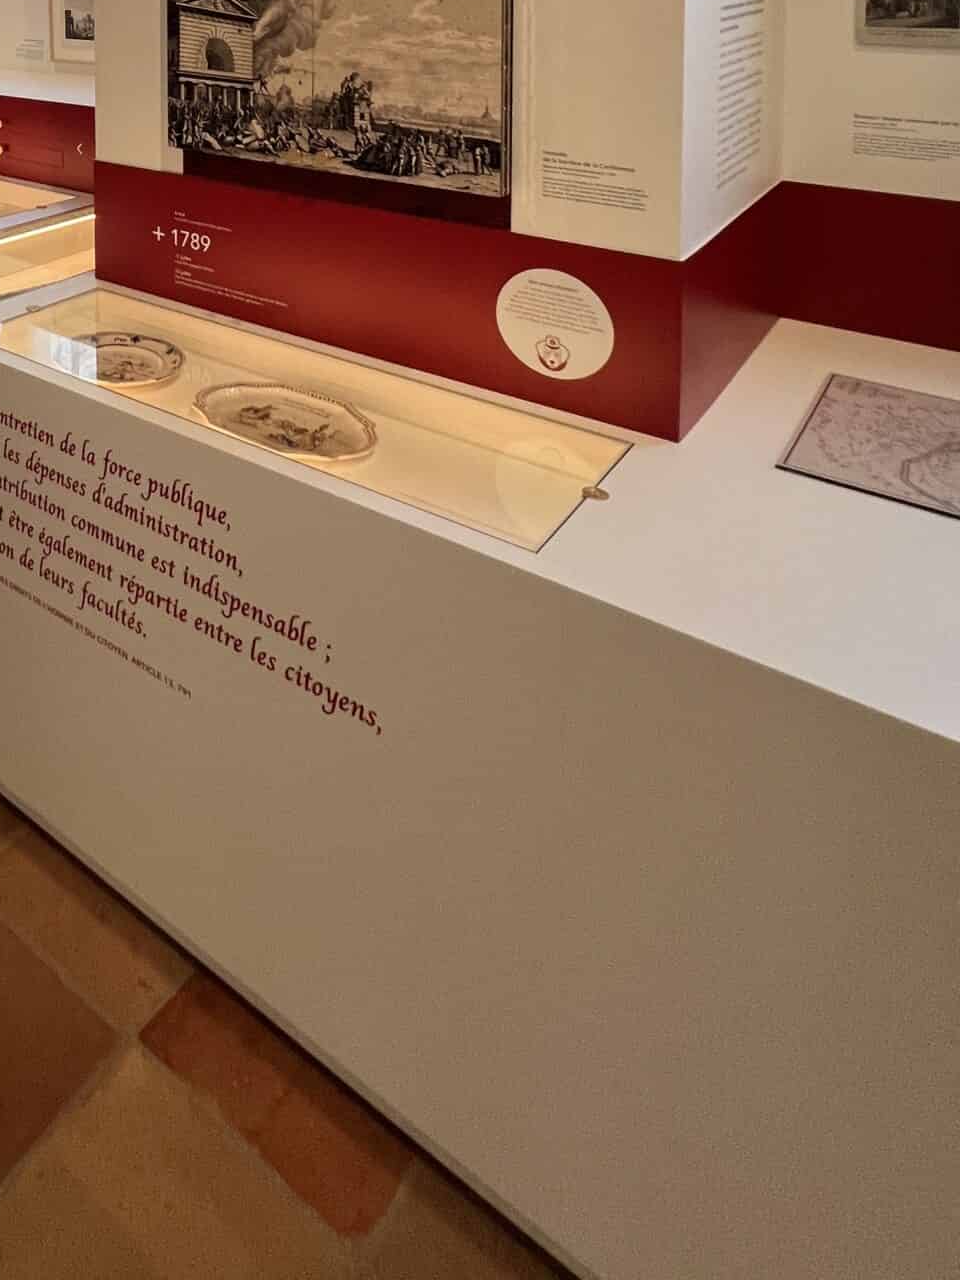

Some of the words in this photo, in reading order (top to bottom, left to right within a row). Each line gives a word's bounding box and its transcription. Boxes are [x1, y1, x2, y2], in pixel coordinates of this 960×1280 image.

[170, 228, 211, 253] 1789
[3, 438, 20, 465] les
[25, 450, 86, 497] dépenses
[92, 481, 243, 578] d'administration,
[60, 431, 77, 457] de
[81, 439, 97, 467] la
[98, 449, 142, 486] force
[141, 478, 231, 532] publique,
[8, 509, 35, 538] être
[38, 527, 113, 581] également
[119, 574, 188, 623] répartie
[194, 616, 243, 653] entre
[250, 635, 277, 672] les
[284, 665, 382, 736] citoyens,
[19, 547, 35, 571] de
[39, 556, 75, 595] leurs
[77, 580, 148, 639] facultés.
[71, 514, 145, 562] commune
[151, 555, 177, 579] est
[183, 565, 318, 652] indispensable
